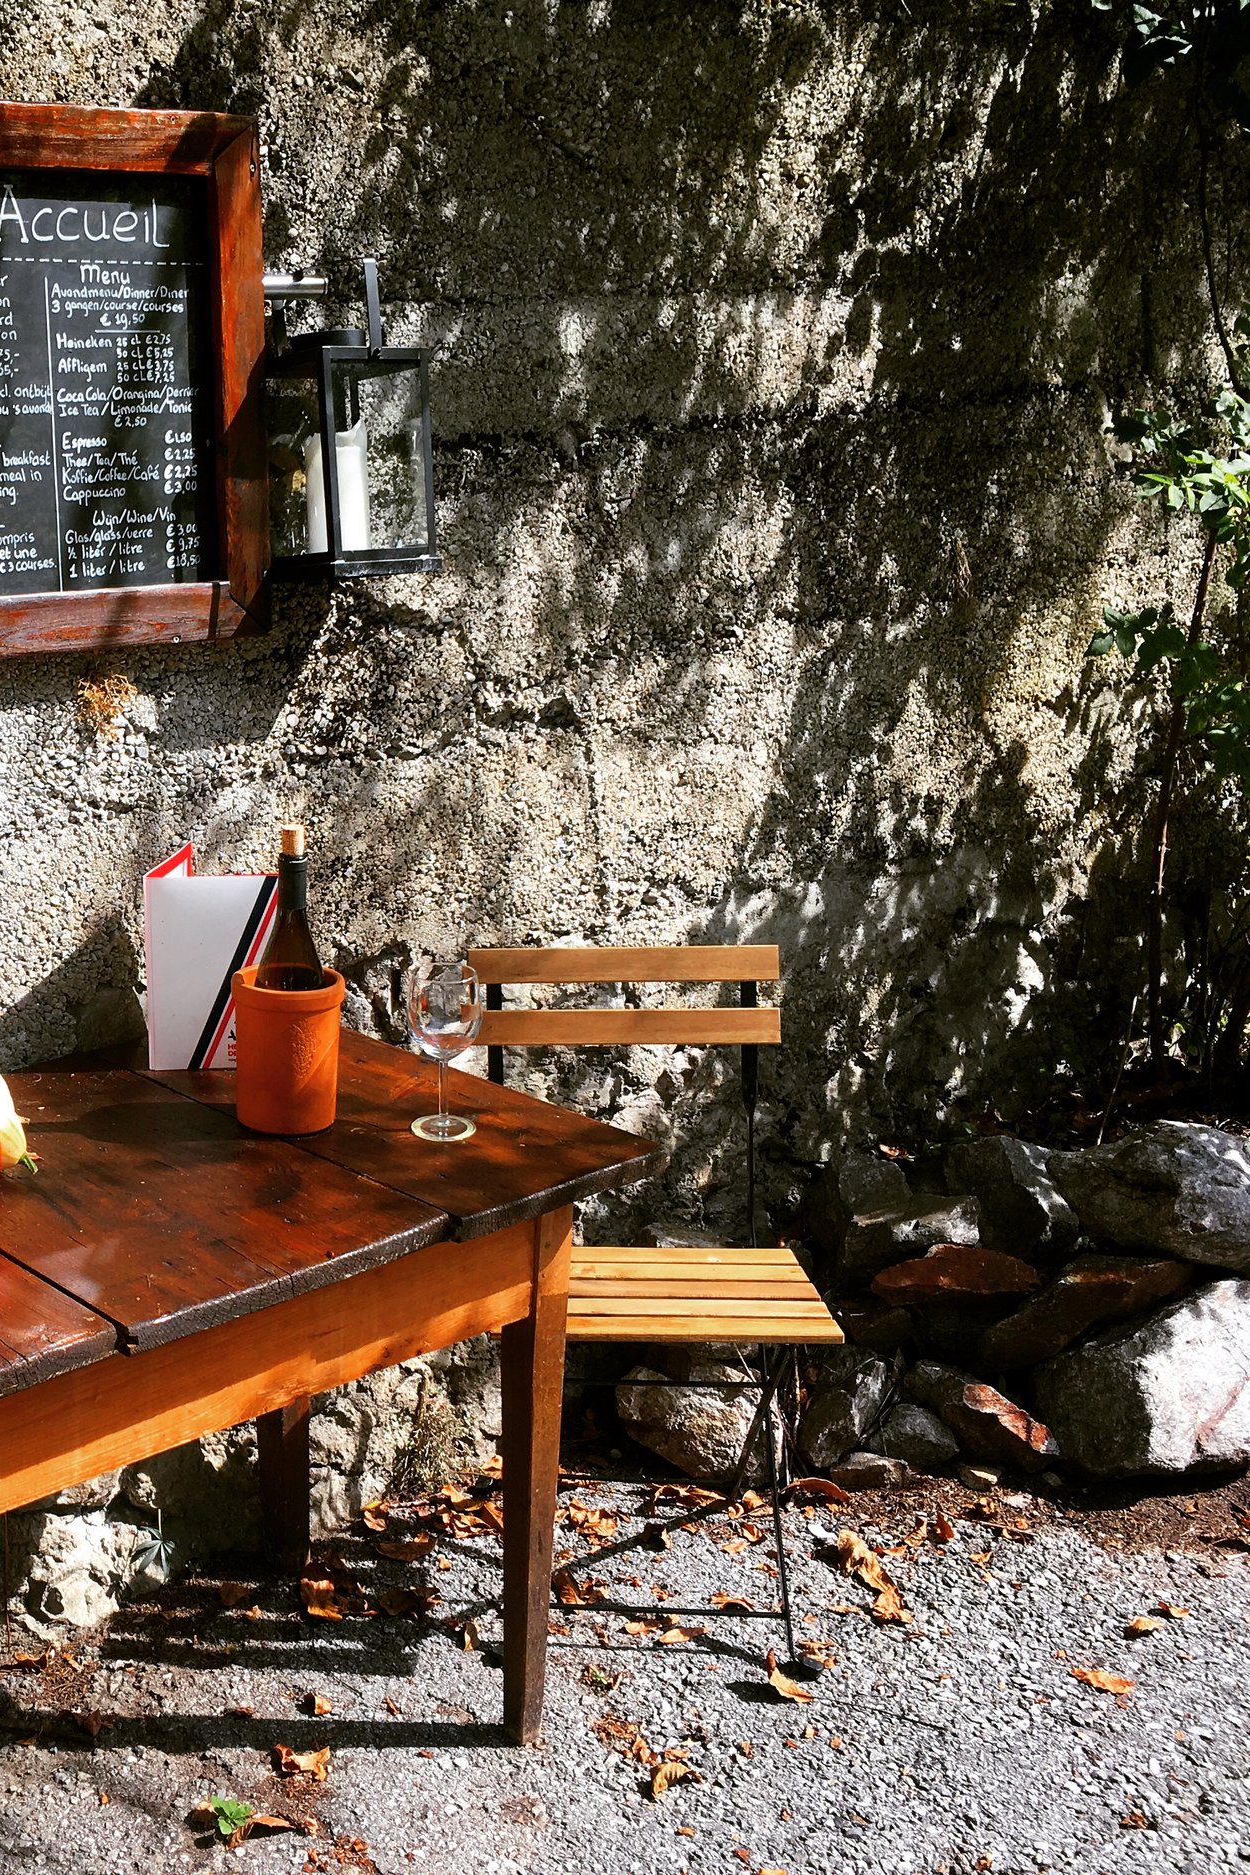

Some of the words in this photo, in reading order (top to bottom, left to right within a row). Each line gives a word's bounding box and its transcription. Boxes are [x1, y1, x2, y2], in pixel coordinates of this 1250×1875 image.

[80, 264, 130, 284] Menu
[51, 300, 60, 313] 3
[65, 299, 184, 318] gangen/course/courses
[56, 332, 112, 350] Heineken
[116, 337, 127, 347] 25
[116, 348, 127, 358] 50
[58, 358, 108, 382] Affligem
[117, 362, 129, 371] 25
[117, 372, 129, 382] 50
[57, 388, 84, 402] Coca
[62, 432, 107, 453] Espresso
[2, 450, 51, 467] breakfast
[62, 449, 138, 468] Thee/Tea/Thé
[0, 468, 26, 482] meal
[30, 469, 42, 481] in
[62, 464, 160, 484] Koffie/Coffee/Café
[63, 486, 125, 506] Cappuccino
[65, 527, 153, 547] Glas/glass/verre
[0, 546, 11, 559] et
[14, 548, 38, 558] une
[82, 544, 106, 560] liter
[119, 543, 143, 555] litre
[15, 558, 57, 571] courses.
[70, 563, 77, 578] 1
[82, 562, 106, 577] liter
[120, 561, 145, 574] litre
